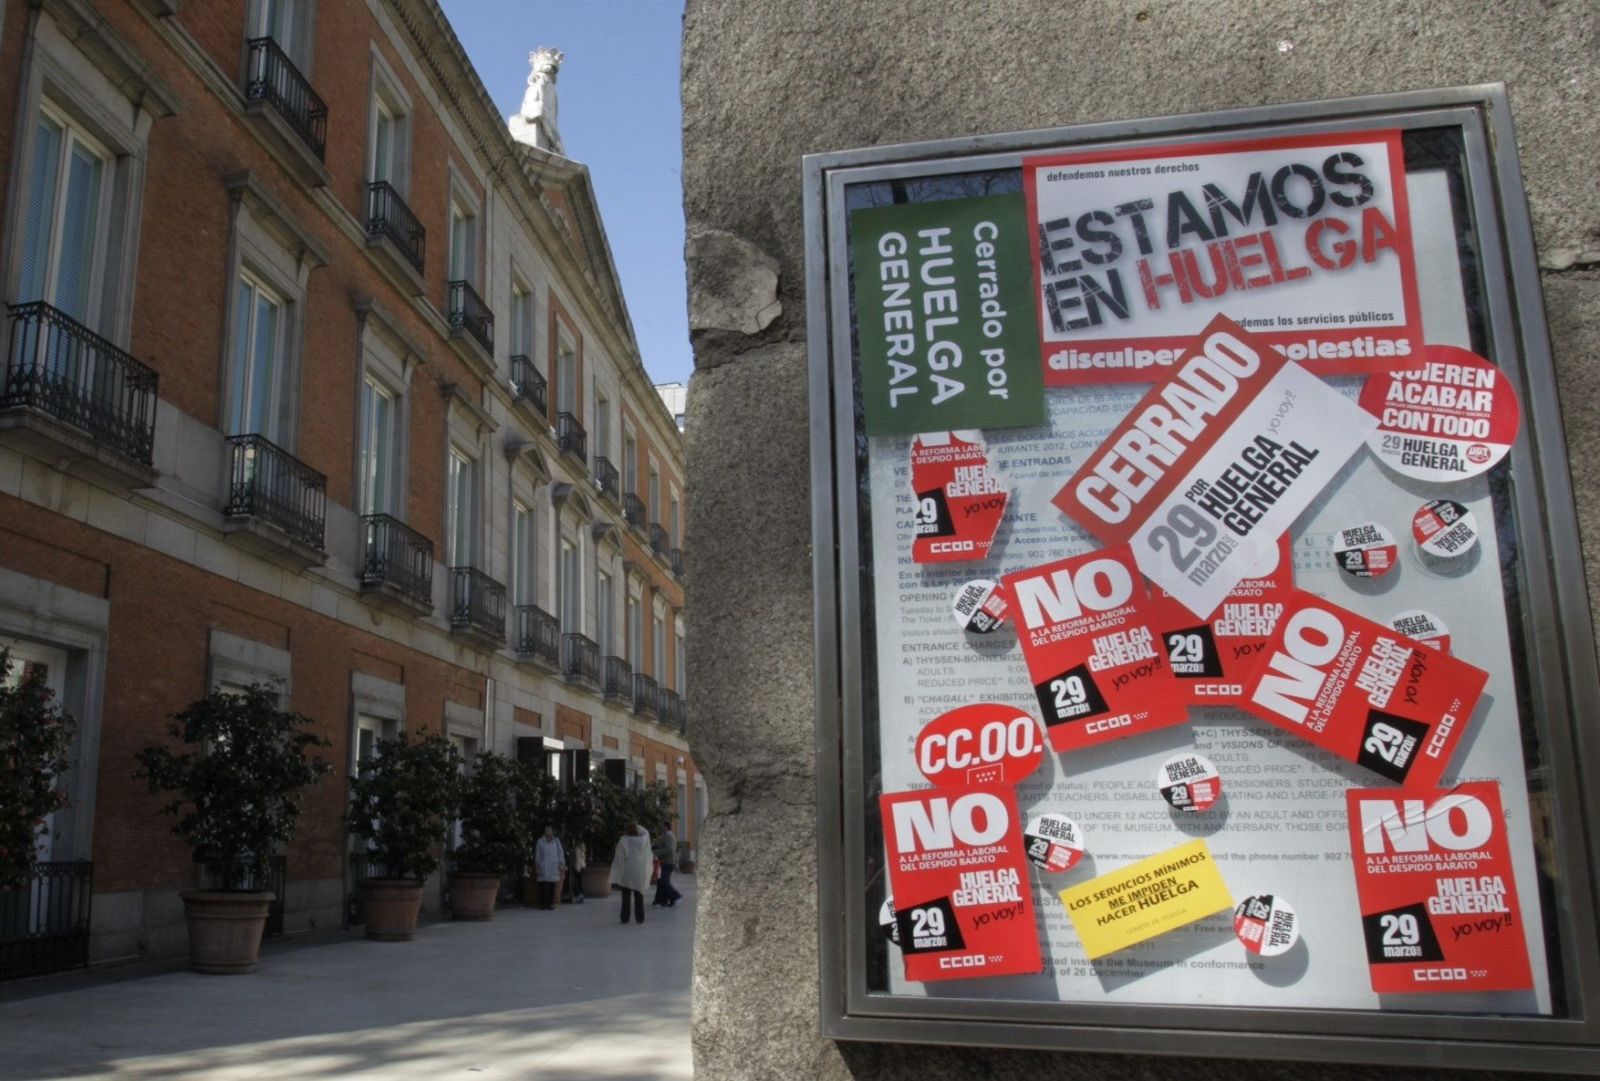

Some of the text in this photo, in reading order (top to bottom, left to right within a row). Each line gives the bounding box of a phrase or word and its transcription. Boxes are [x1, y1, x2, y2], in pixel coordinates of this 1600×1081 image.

[1046, 162, 1200, 182] defendemos nuestros derechos
[1039, 151, 1374, 276] ESTAMOS
[1042, 206, 1401, 334] EN HUELGA
[878, 231, 919, 408] GENERAL
[917, 227, 965, 405] HUELGA
[973, 220, 1009, 400] Cerrado por
[1277, 311, 1394, 327] los servicios públicos
[1385, 380, 1493, 413] ACABAR
[1075, 331, 1260, 524] CERRADO
[1382, 408, 1429, 430] CON
[1432, 413, 1490, 438] TODO
[1381, 434, 1402, 449] 29
[1402, 438, 1458, 458] HUELGA
[1197, 434, 1284, 520] HUELGA
[1401, 452, 1467, 473] GENERAL
[1184, 477, 1210, 503] POR
[1222, 440, 1320, 537] GENERAL
[1147, 503, 1217, 573] 29
[1342, 524, 1377, 539] HUELGA
[1344, 533, 1384, 548] GENERAL
[1188, 540, 1232, 587] marzo
[1345, 551, 1362, 565] 29
[1014, 558, 1133, 630] NO
[1030, 606, 1137, 639] A LA REFORMA LABORAL
[1032, 616, 1126, 647] DEL DESPIDO BARATO
[902, 641, 959, 653] ENTRANCE
[1092, 625, 1153, 656] HUELGA
[1169, 634, 1204, 663] 29
[1088, 640, 1158, 673] GENERAL
[1171, 662, 1200, 674] marzo
[1251, 607, 1345, 725] NO
[1354, 636, 1396, 694] HUELGA
[1112, 673, 1129, 691] yo
[1310, 630, 1361, 721] LA REFORMA LABORAL
[1313, 645, 1362, 733] DEL DESPIDO BARATO
[1367, 644, 1414, 709] GENERAL
[1051, 675, 1087, 709] 29
[1404, 686, 1418, 705] yo
[1056, 702, 1086, 719] marzo
[921, 716, 1043, 775] CC.OO.
[1364, 722, 1404, 763] 29
[1393, 737, 1417, 768] marzo
[1165, 757, 1198, 773] HUELGA
[1169, 765, 1208, 782] GENERAL
[1170, 785, 1188, 800] 29
[891, 792, 1009, 854] NO
[1038, 826, 1075, 842] GENERAL
[1040, 817, 1072, 831] HUELGA
[1359, 794, 1493, 854] NO
[899, 845, 1009, 863] A LA REFORMA LABORAL
[1030, 838, 1049, 855] 29
[1366, 851, 1493, 865] A LA REFORMA LABORAL
[900, 855, 996, 872] DEL DESPIDO BARATO
[960, 867, 1020, 889] HUELGA
[1367, 860, 1478, 874] DEL DESPIDO BARATO
[1069, 851, 1207, 911] LOS SERVICIOS MÍNIMOS
[1108, 876, 1178, 910] ME IMPIDEN
[1436, 875, 1506, 896] HUELGA
[952, 885, 1023, 907] GENERAL
[1096, 879, 1199, 927] HACER HUELGA
[1428, 893, 1510, 915] GENERAL
[911, 907, 945, 938] 29
[972, 914, 989, 930] yo
[1380, 913, 1420, 945] 29
[1451, 923, 1472, 941] yo
[913, 936, 942, 949] marzo
[1383, 945, 1417, 957] marzo
